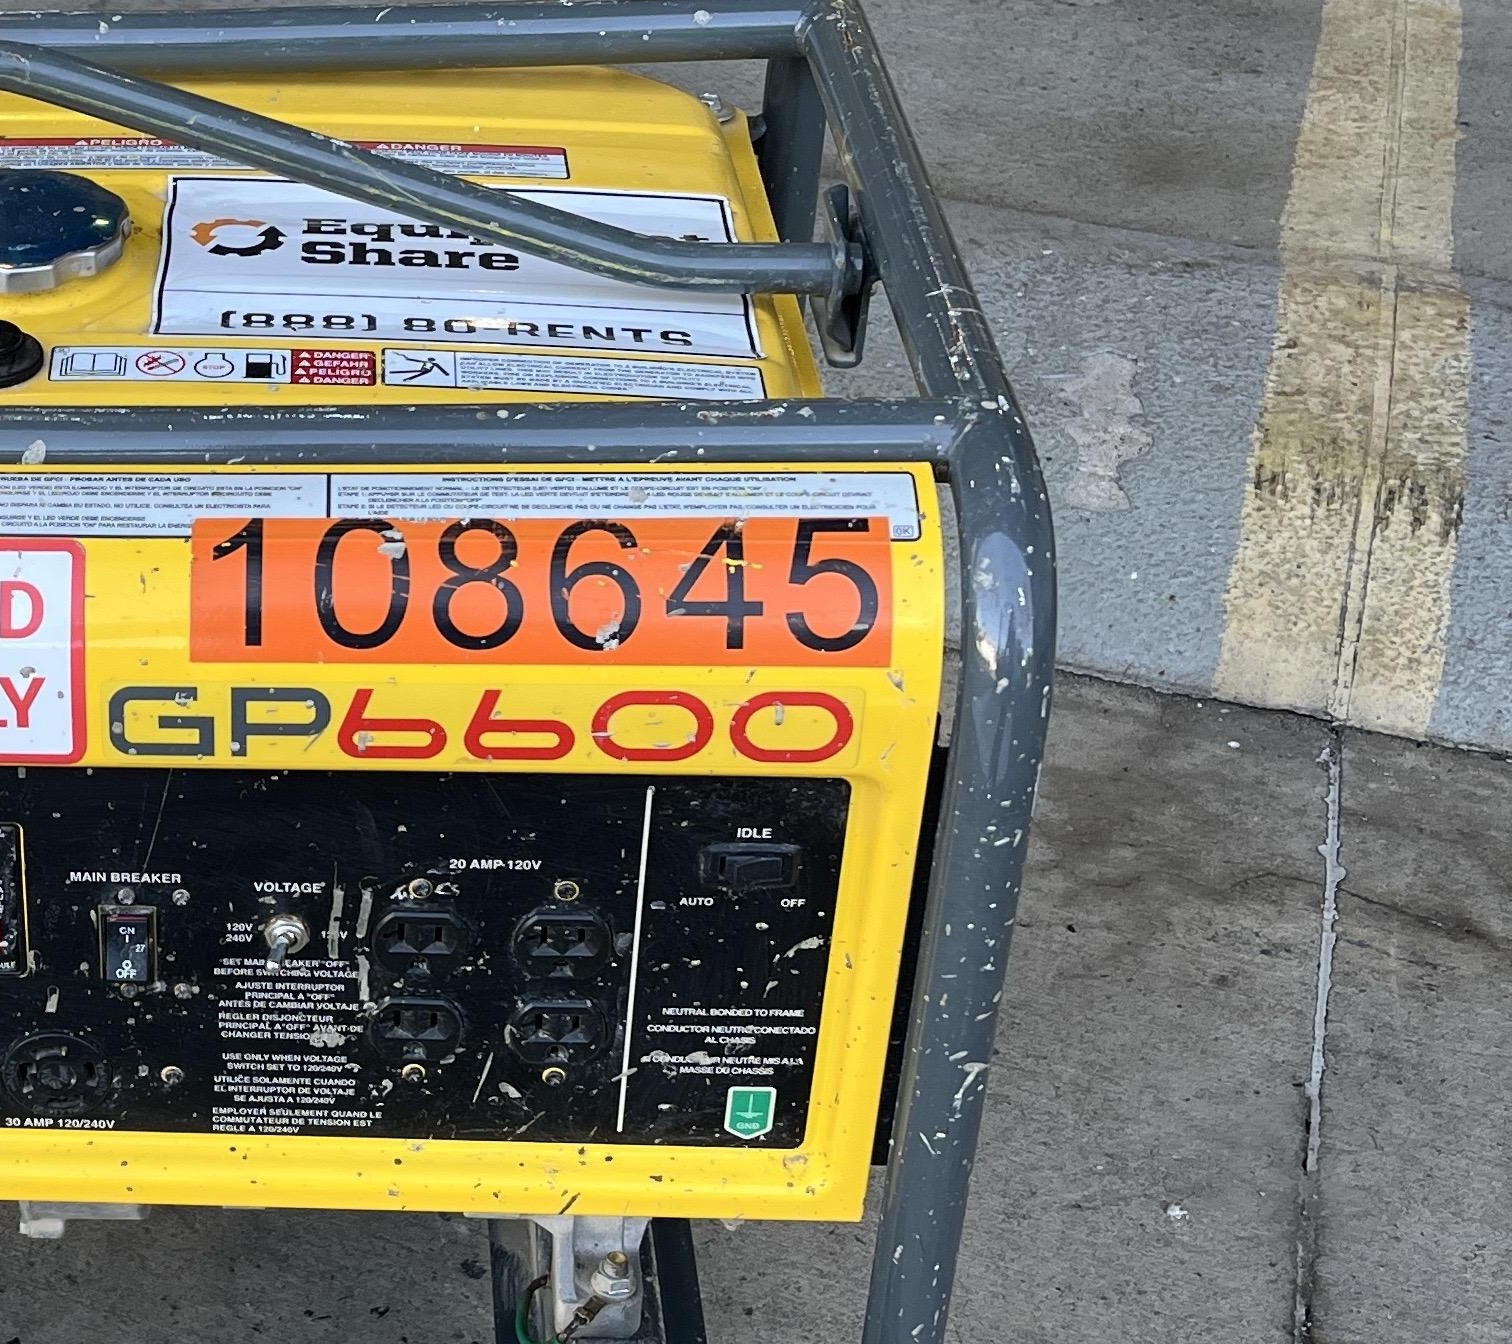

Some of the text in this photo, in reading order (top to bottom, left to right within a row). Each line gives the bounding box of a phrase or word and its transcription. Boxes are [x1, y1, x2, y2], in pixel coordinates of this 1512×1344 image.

[301, 241, 519, 271] Share
[307, 360, 368, 368] GEFAHR
[308, 368, 372, 376] PELIGRO
[313, 376, 368, 384] DANGER
[211, 518, 881, 652] 108645
[108, 686, 854, 762] GP6600
[736, 828, 772, 839] IDLE
[449, 859, 466, 869] 20
[70, 872, 182, 883] MAIN BREAKER
[680, 897, 714, 906] AUTO
[780, 898, 806, 908] OFF
[226, 923, 253, 932] 120V
[225, 934, 253, 942] 240V
[136, 944, 146, 953] 27
[116, 969, 136, 979] OFF
[214, 968, 359, 978] BEFORE VOLTAGE
[275, 983, 345, 992] INTERRUPTOR
[268, 1001, 314, 1009] CAMBIAR
[316, 1002, 359, 1011] VOLTAJE
[662, 1008, 708, 1016] NEUTRAL
[769, 1009, 804, 1017] FRAME
[218, 1013, 334, 1023] REGLER DISJONCTEUR
[647, 1025, 710, 1033] CONDUCTOR
[221, 1031, 271, 1039] CHANGER
[272, 1054, 301, 1062] WHEN
[303, 1055, 347, 1063] VOLTAGE
[267, 1063, 285, 1071] SET
[253, 1076, 311, 1085] SOLAMENTE
[314, 1078, 356, 1086] CUANDO
[228, 1085, 296, 1094] INTERRUPTOR
[314, 1087, 355, 1096] VOLTAJE
[212, 1107, 267, 1115] EMPLOYER
[269, 1108, 328, 1117] SEULEMENT
[331, 1110, 367, 1118] QUAND
[5, 1117, 115, 1129] 30 AMP 120/240V
[212, 1116, 372, 1127] COMMUTATEUR DE TENSION EST
[213, 1124, 246, 1132] REGLE
